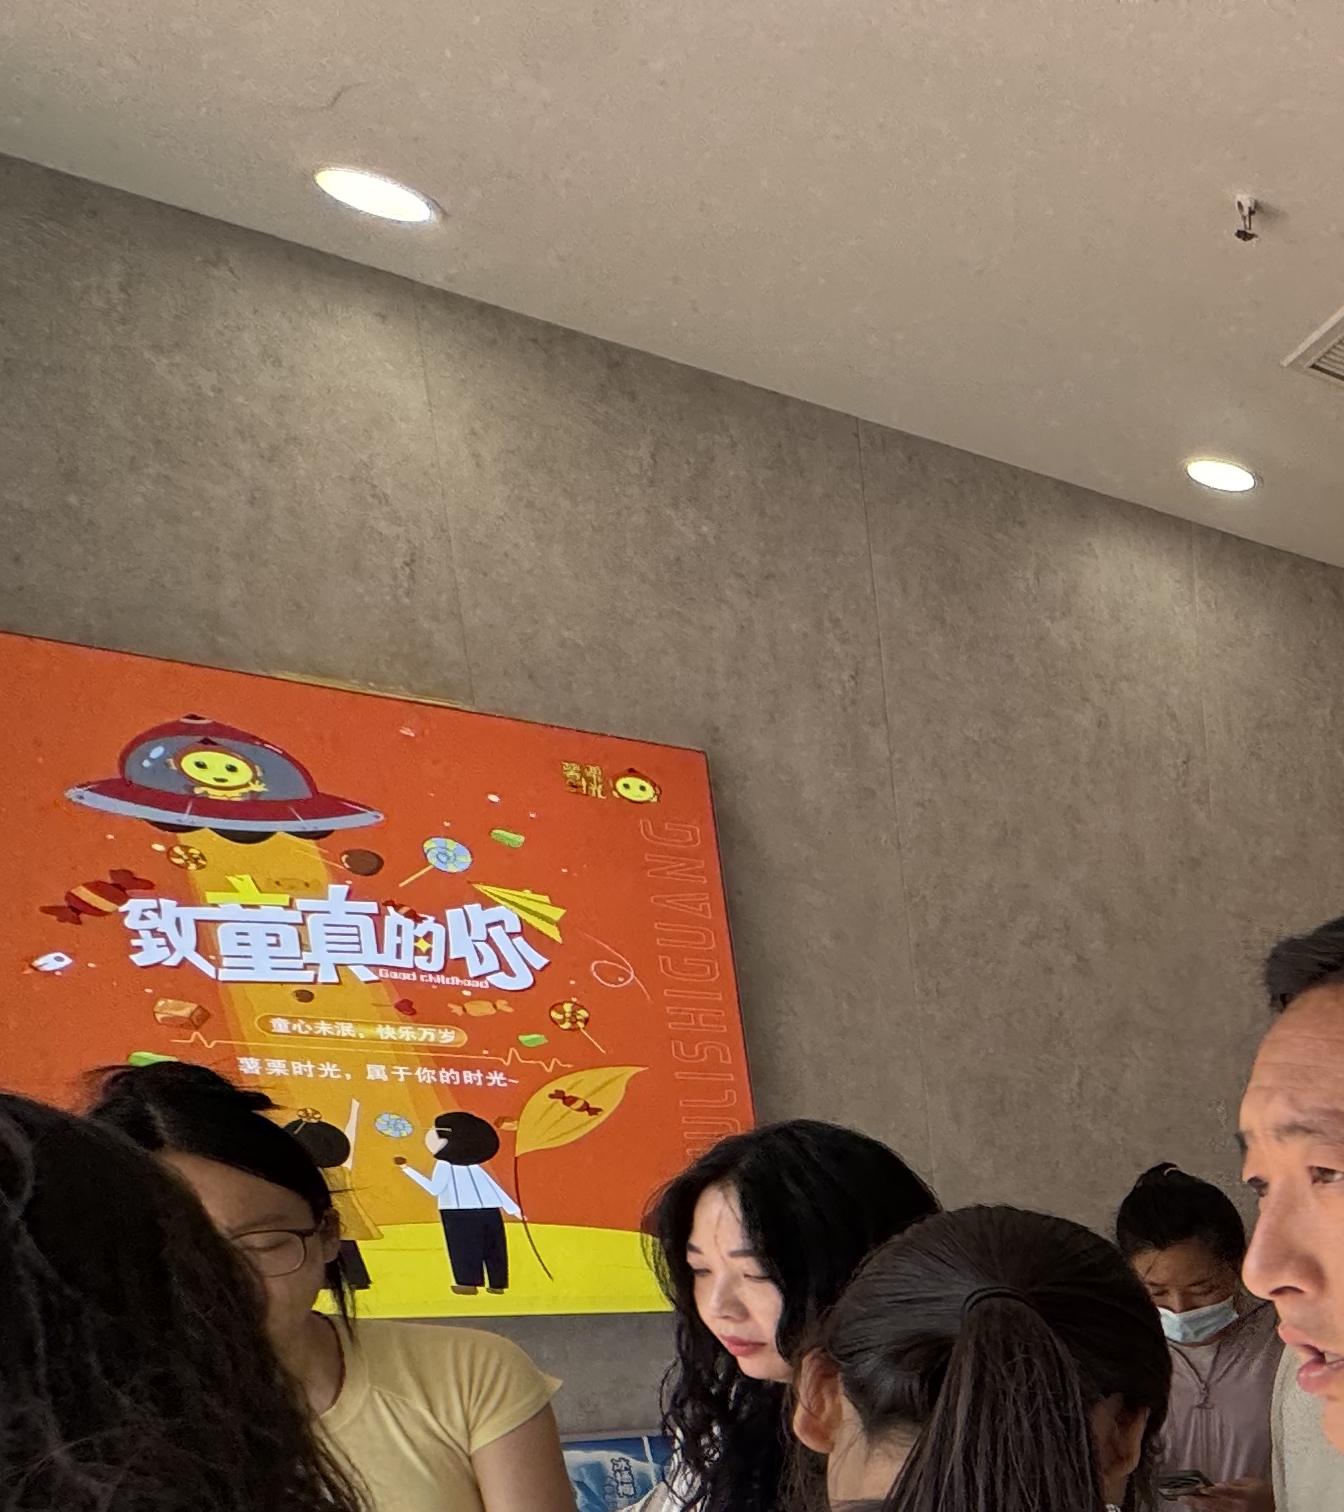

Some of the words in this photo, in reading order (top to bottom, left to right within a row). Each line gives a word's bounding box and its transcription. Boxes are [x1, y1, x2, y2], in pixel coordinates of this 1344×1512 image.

[119, 874, 550, 991] 致童真的你
